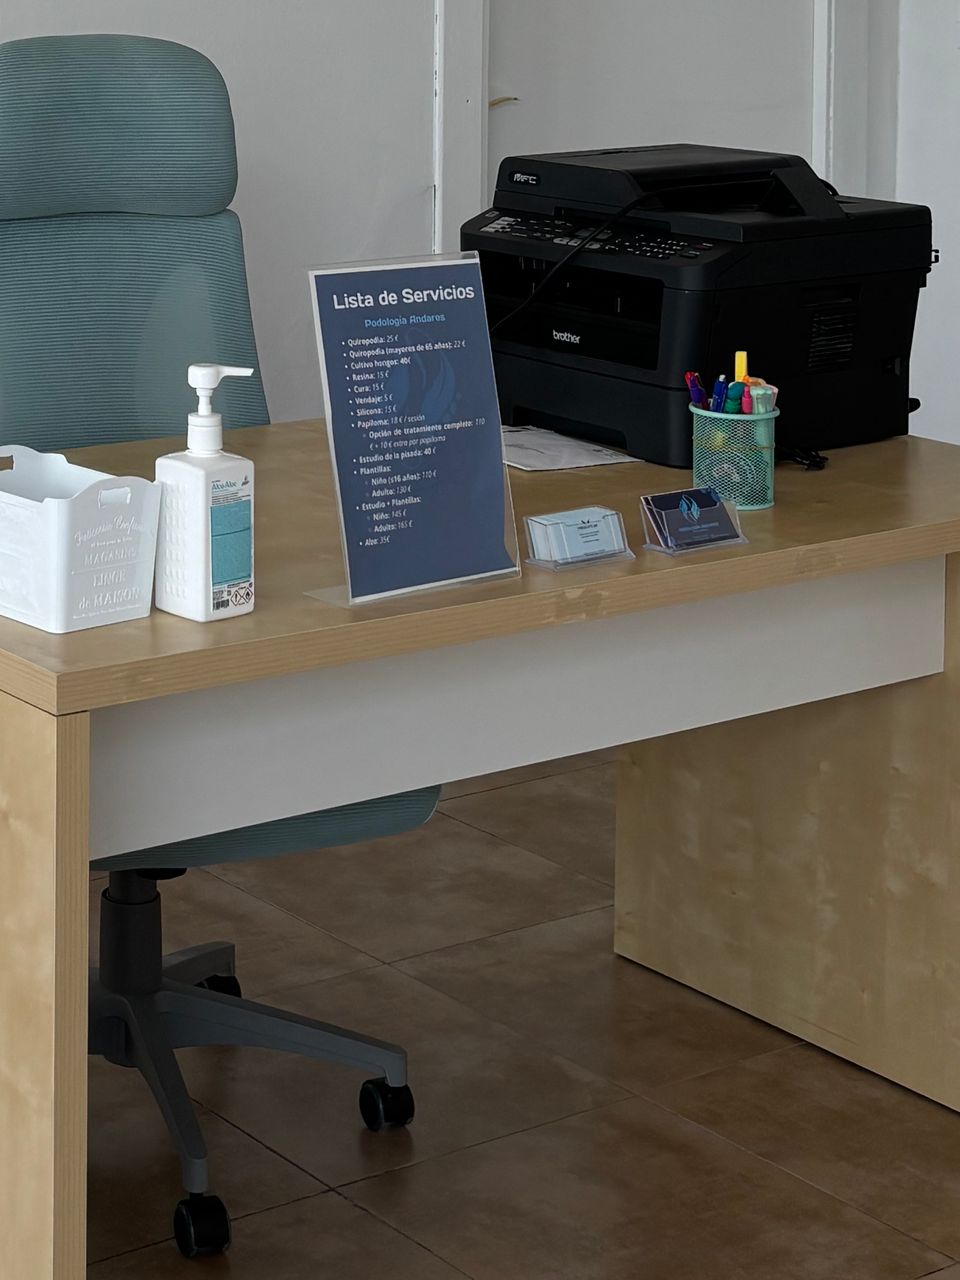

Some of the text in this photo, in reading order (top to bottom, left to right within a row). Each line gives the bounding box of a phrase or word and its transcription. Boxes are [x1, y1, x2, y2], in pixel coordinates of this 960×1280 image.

[513, 173, 537, 184] MFC
[333, 285, 475, 310] Lista de Servicios
[364, 313, 446, 328] Podología Andares
[347, 334, 399, 347] Quiropodia: 25 €
[552, 329, 581, 344] brother
[349, 348, 385, 359] Quiropodia
[386, 344, 416, 356] (mayores
[416, 343, 425, 352] de
[425, 341, 433, 350] 65
[461, 339, 466, 347] €
[350, 360, 374, 370] Cultivo
[374, 357, 399, 369] hongos:
[352, 370, 389, 381] Resina: 15 €
[353, 383, 385, 393] Cura: 15 €
[355, 395, 383, 406] Vendaje:
[384, 394, 389, 402] 5
[356, 407, 384, 417] Silicona:
[384, 405, 392, 413] 15
[357, 418, 390, 430] Papiloma:
[368, 428, 392, 439] Opción
[393, 427, 402, 436] de
[403, 423, 442, 435] tratamiento
[443, 420, 473, 431] completo:
[408, 438, 419, 448] por
[359, 453, 384, 464] Estudio
[384, 451, 393, 460] de
[393, 450, 400, 459] la
[400, 448, 423, 461] pisada:
[360, 465, 392, 475] Plantillas:
[371, 476, 387, 486] Niño
[372, 488, 395, 497] Adulto:
[361, 501, 386, 511] Estudio
[391, 496, 422, 507] Plantillas:
[373, 511, 390, 521] Niño:
[374, 523, 397, 533] Adulto:
